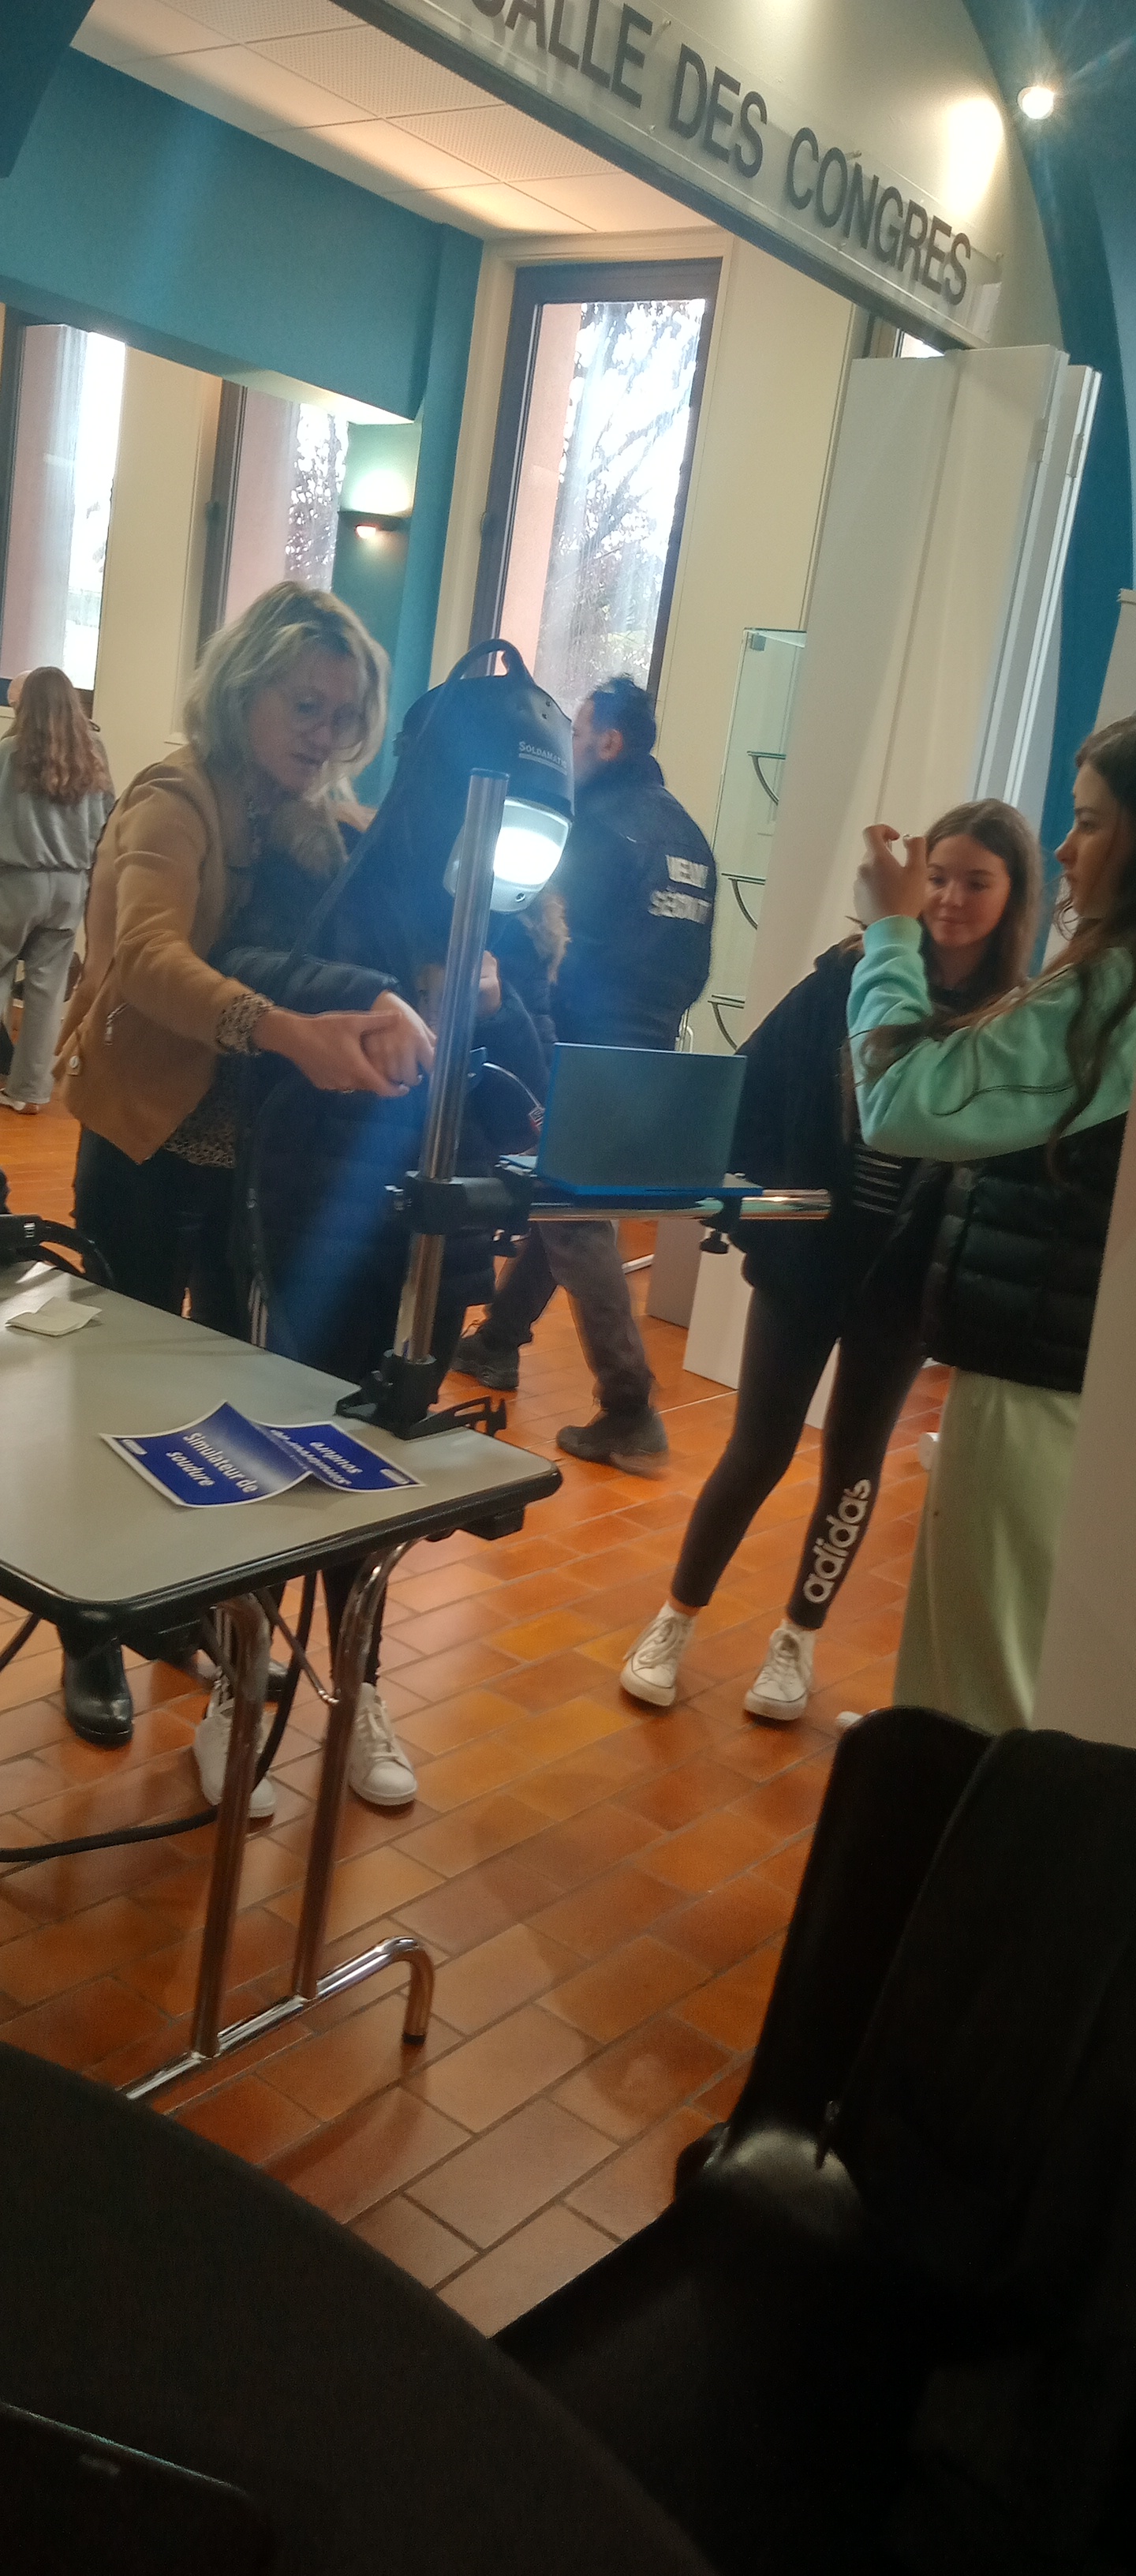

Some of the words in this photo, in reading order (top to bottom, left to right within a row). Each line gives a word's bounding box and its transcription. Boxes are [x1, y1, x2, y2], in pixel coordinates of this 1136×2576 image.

[473, 0, 652, 109] ALLE
[669, 43, 768, 178] DES
[787, 127, 972, 305] CONGRES
[166, 1451, 215, 1487] soudure
[183, 1432, 245, 1480] Simulateur
[236, 1478, 259, 1493] de
[802, 1479, 872, 1604] adidas
